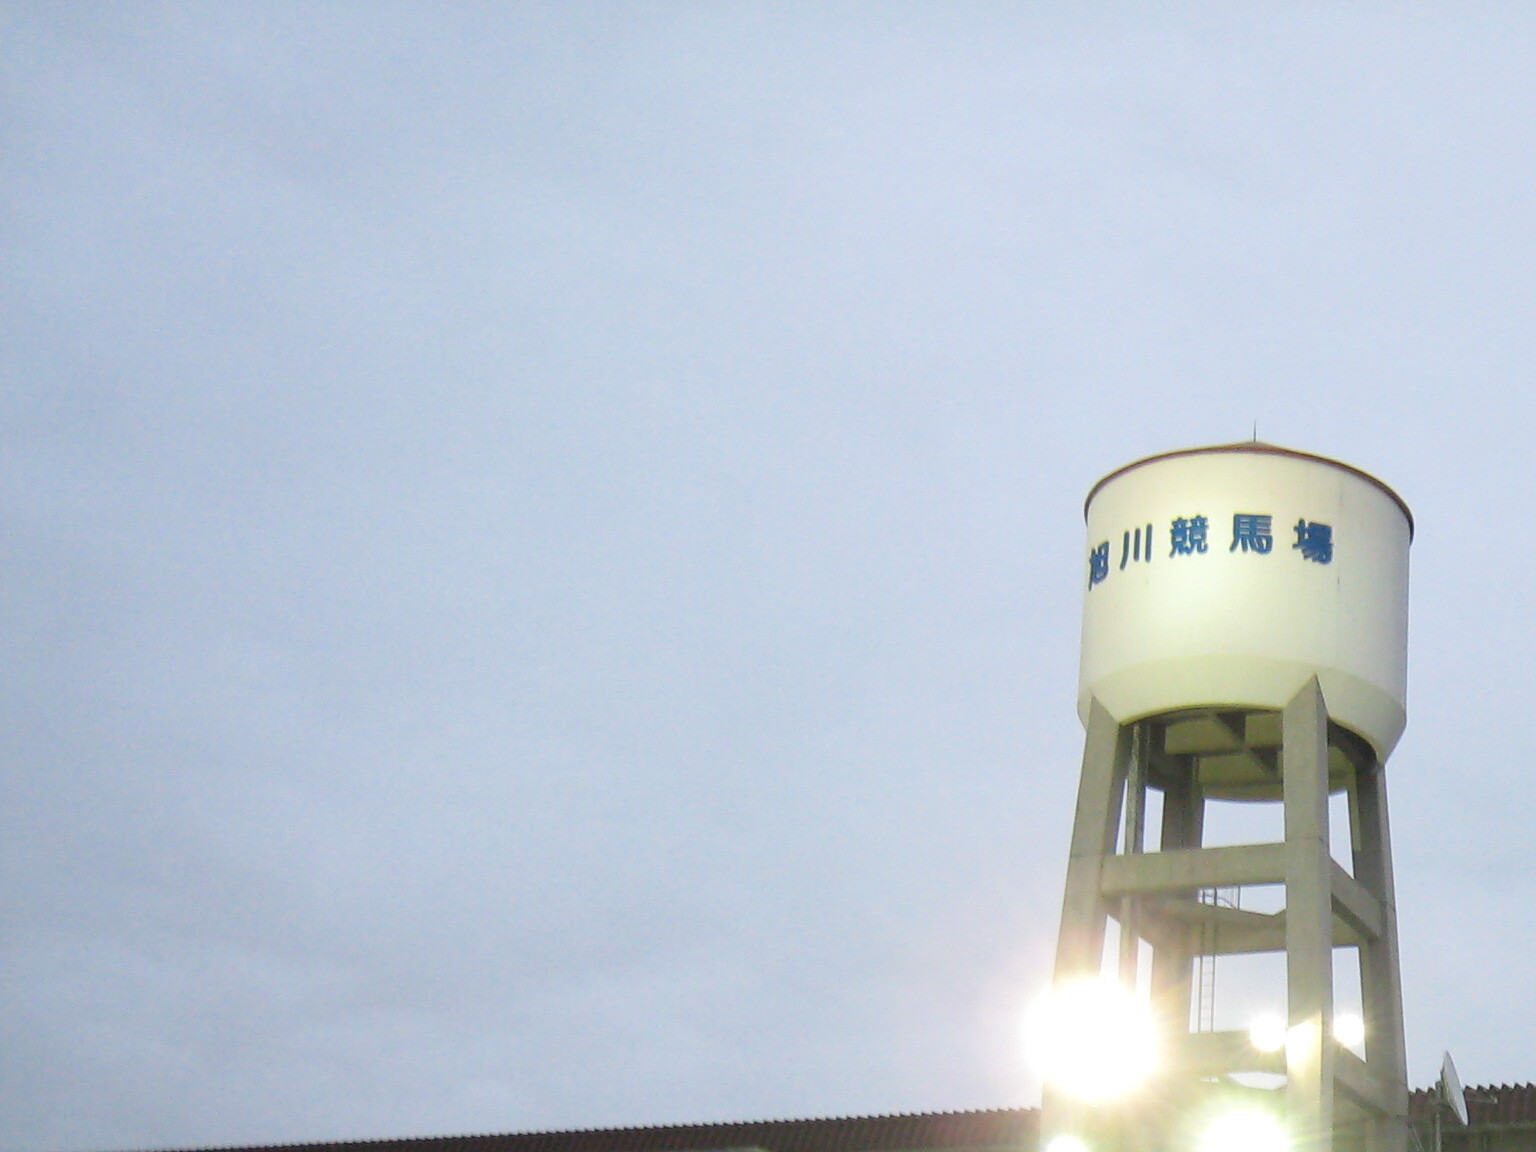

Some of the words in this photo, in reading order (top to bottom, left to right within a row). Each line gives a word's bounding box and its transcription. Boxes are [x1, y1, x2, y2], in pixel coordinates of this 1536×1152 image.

[1088, 514, 1334, 591] 旭川競馬場
